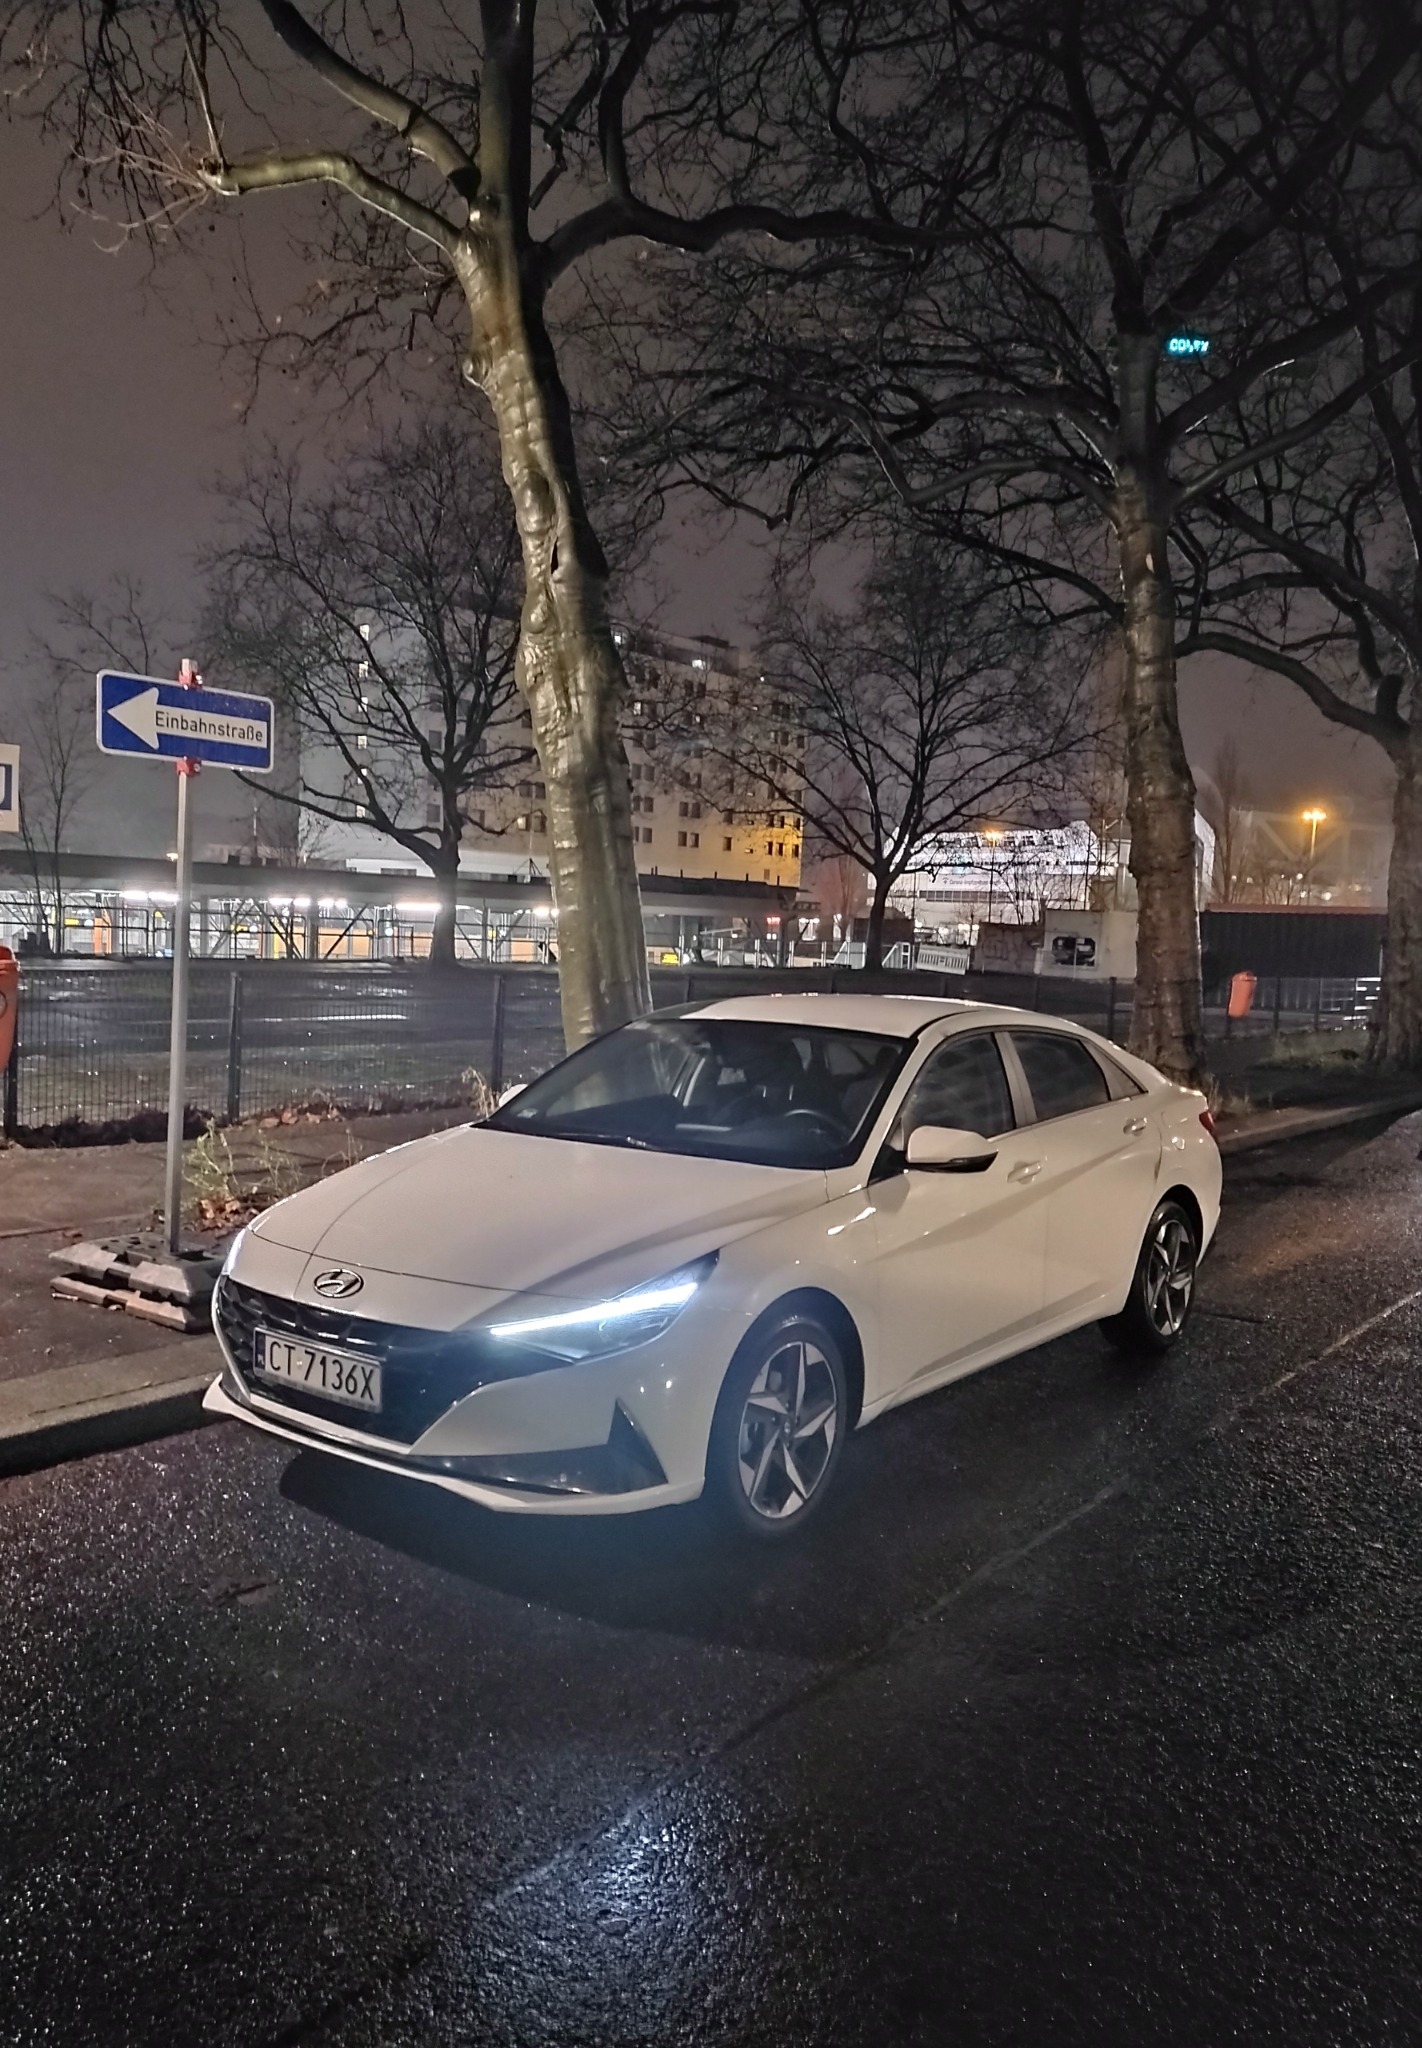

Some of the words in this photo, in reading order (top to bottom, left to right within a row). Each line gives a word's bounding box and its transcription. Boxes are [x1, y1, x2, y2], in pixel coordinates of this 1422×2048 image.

[155, 711, 263, 742] Einbahnstraße
[270, 1341, 296, 1376] CT
[304, 1351, 374, 1401] 7136X
